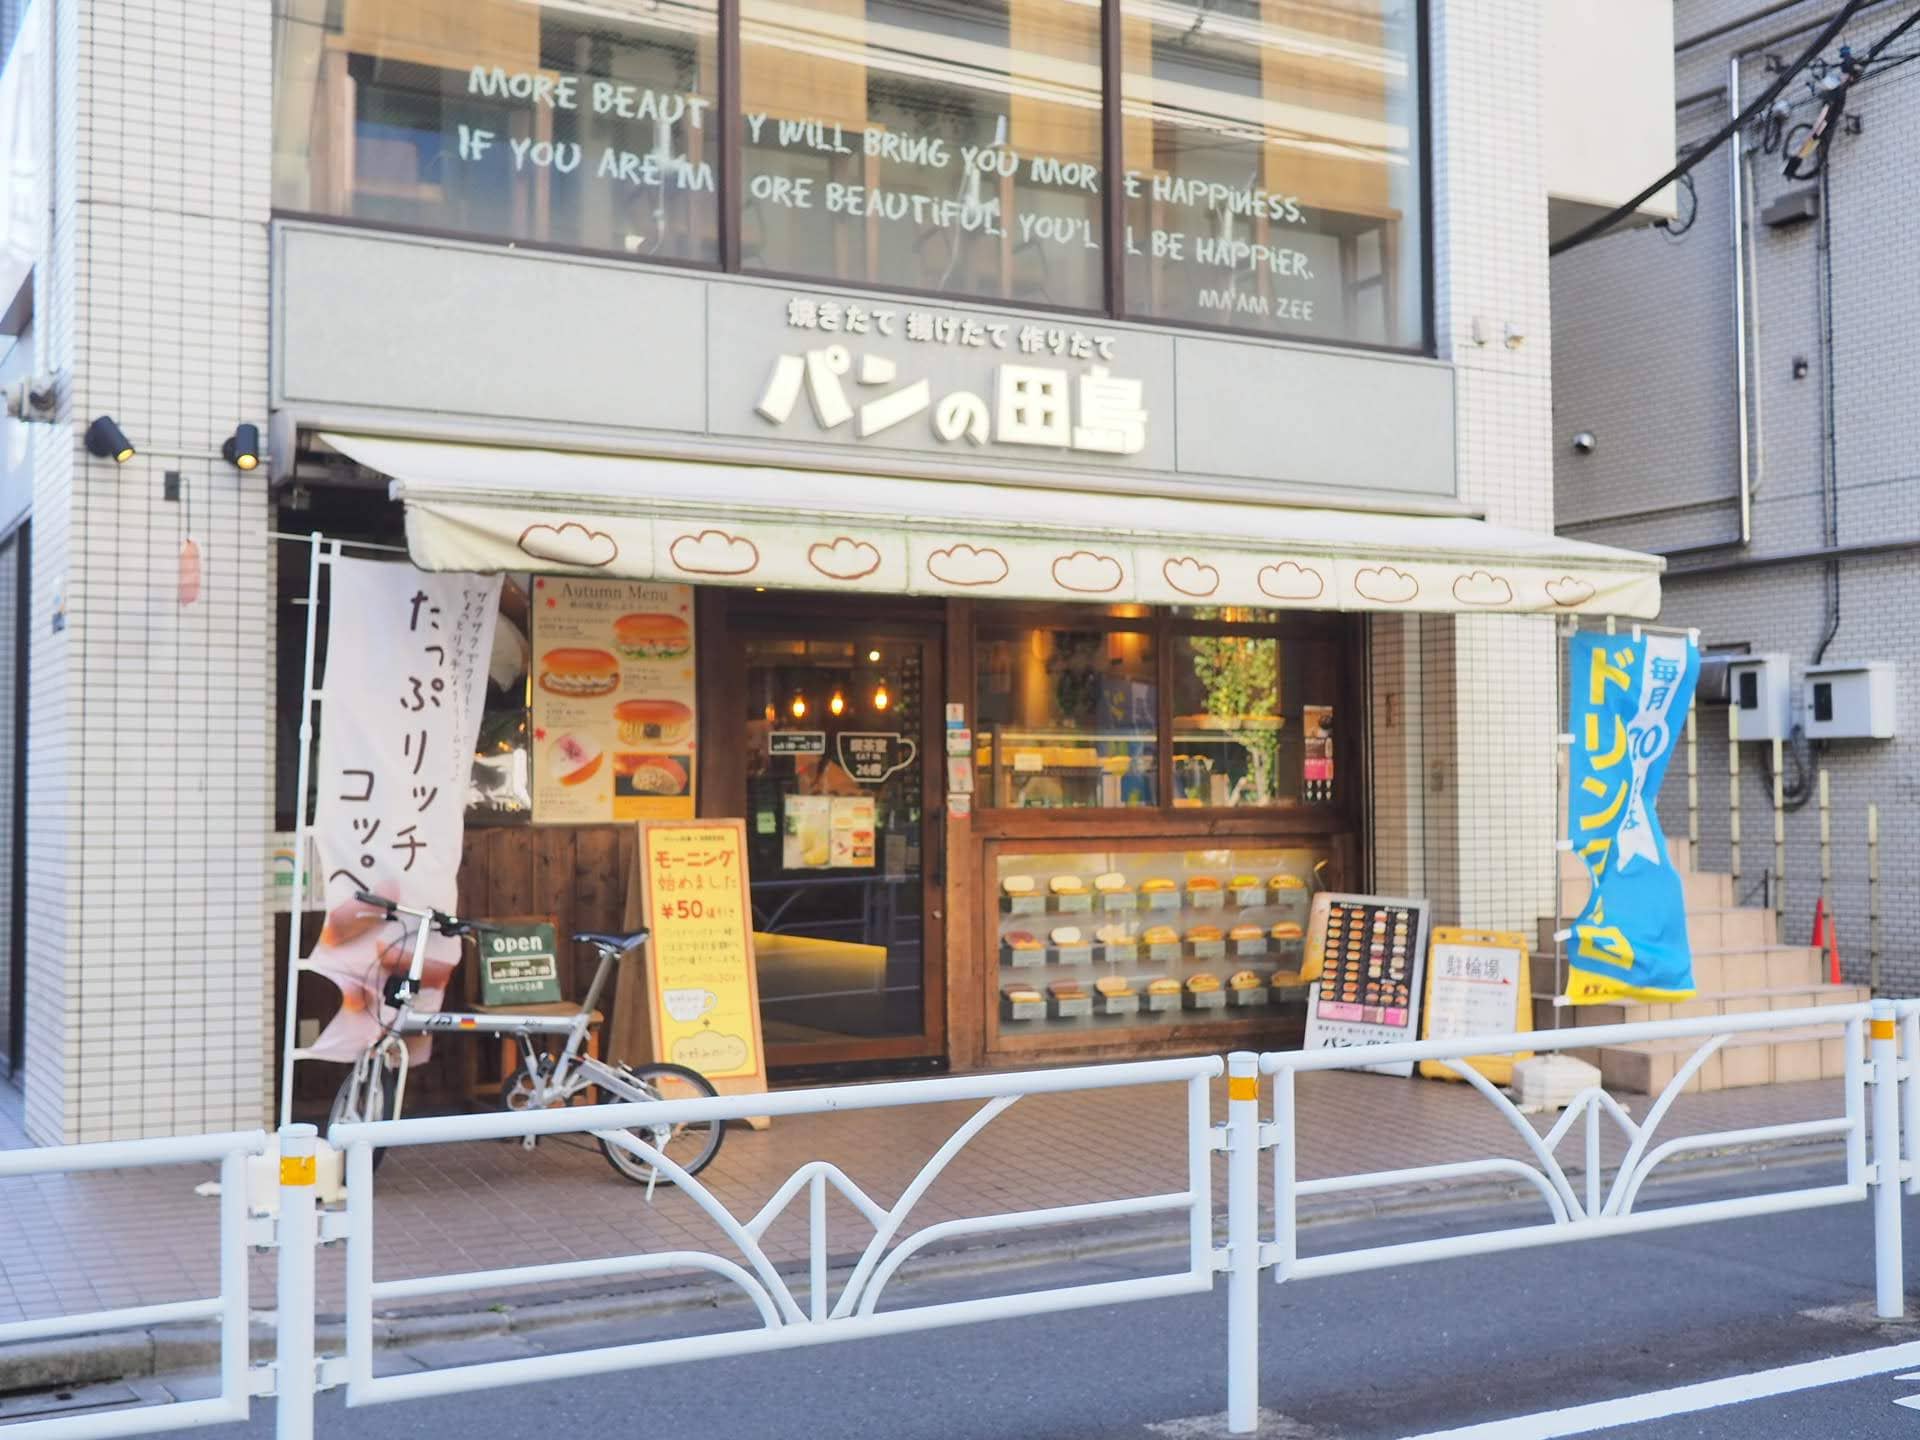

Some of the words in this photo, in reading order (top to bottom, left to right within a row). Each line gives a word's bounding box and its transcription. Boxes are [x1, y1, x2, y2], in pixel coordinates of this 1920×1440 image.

[468, 65, 579, 109] MORE
[778, 116, 853, 154] WILL
[961, 146, 1019, 177] YOU
[458, 124, 496, 161] IF
[510, 136, 582, 175] YOU
[597, 147, 663, 186] ARE
[1151, 230, 1185, 261] BE
[787, 298, 896, 336] 焼きたて
[907, 311, 1008, 349] 揚げたて
[1018, 325, 1117, 360] 作りたて
[1276, 298, 1314, 321] ZEE
[754, 344, 1150, 455] パンの田島
[560, 583, 622, 601] Autumn
[628, 585, 669, 602] Menu
[329, 769, 382, 893] コッペ
[655, 849, 736, 870] モーニング
[657, 871, 738, 893] 始めました
[493, 935, 543, 954] open
